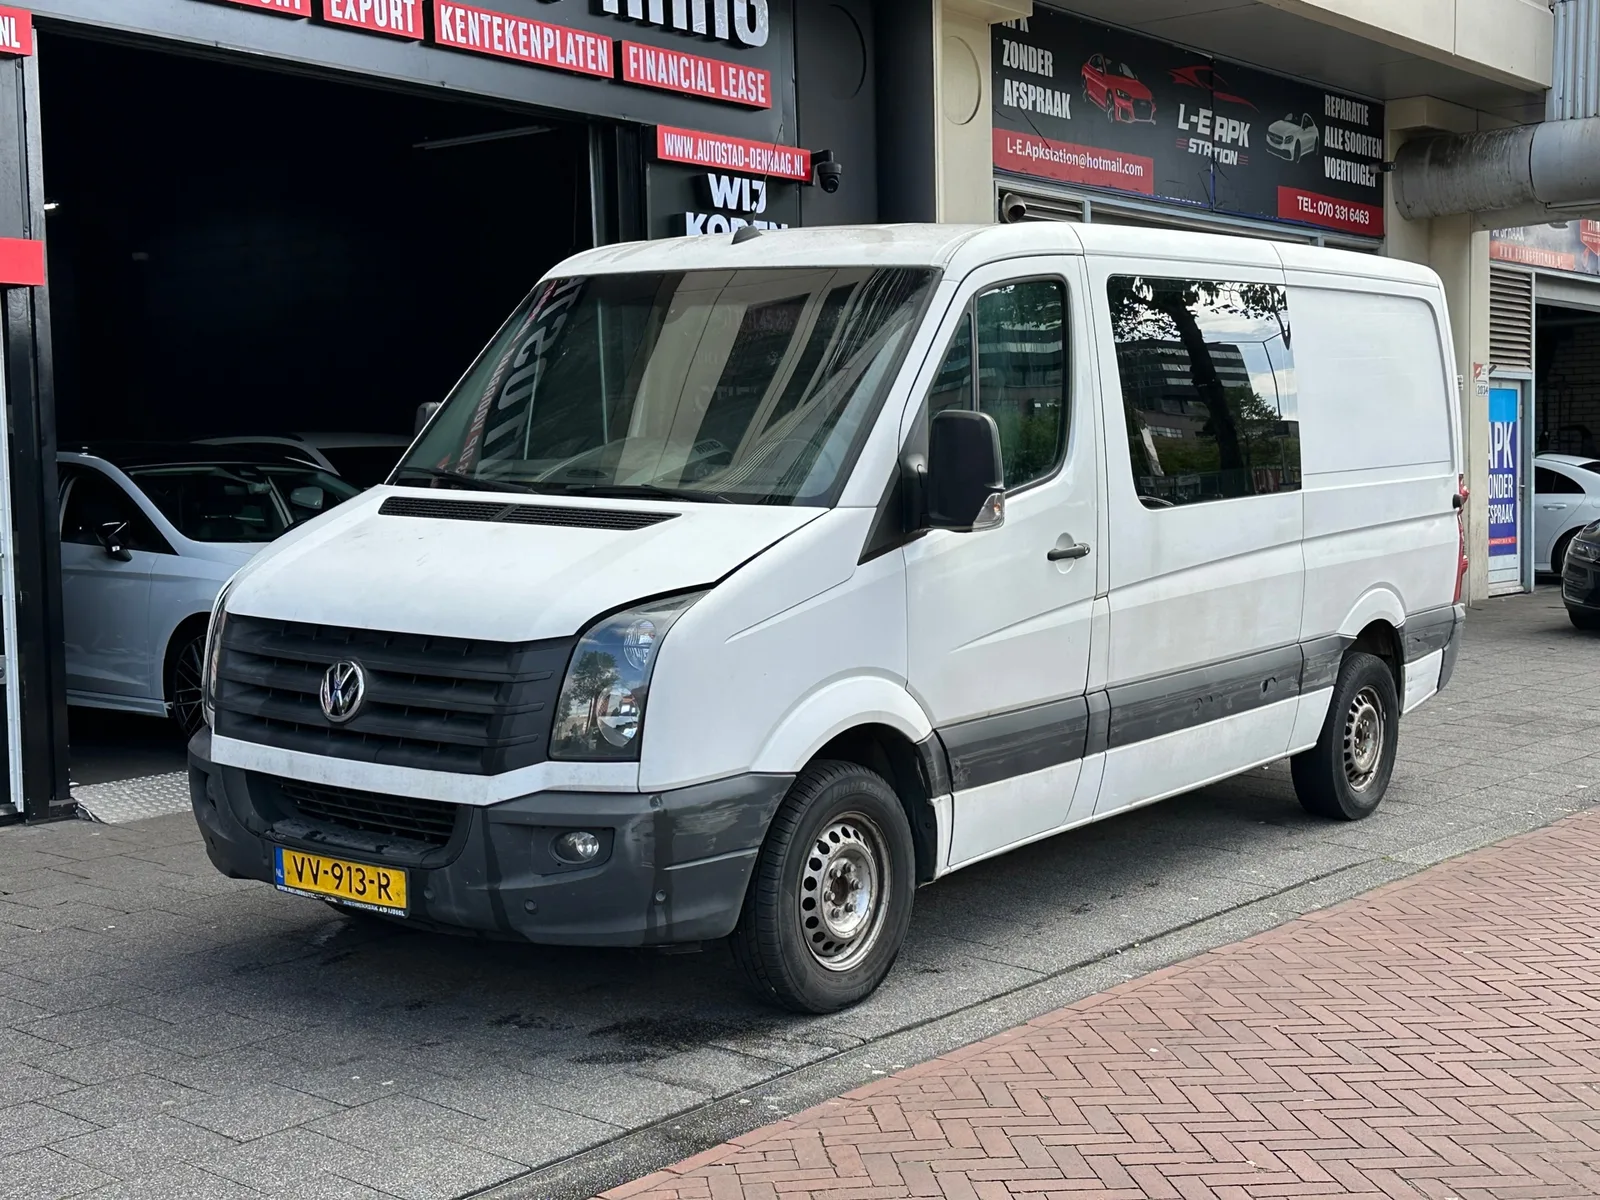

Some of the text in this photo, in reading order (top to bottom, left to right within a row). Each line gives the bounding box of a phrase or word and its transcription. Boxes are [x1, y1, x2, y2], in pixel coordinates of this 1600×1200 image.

[440, 4, 609, 72] KENTEKENPLATEN
[1003, 38, 1053, 77] ZONDER
[629, 46, 766, 103] FINANCIAL LEASE
[1003, 78, 1071, 119] AFSPRAAK
[1324, 94, 1369, 126] REPARATIE
[1177, 103, 1251, 148] L-E APK
[1324, 125, 1382, 159] ALLE SOORTEN
[664, 132, 806, 177] WWW.AUTOSTAD-DENHAAG.NL
[1007, 137, 1143, 177] L-E.Apkstation@hotmail.com
[1188, 137, 1238, 166] STATION
[707, 172, 767, 214] WIJ
[1297, 195, 1370, 224] TEL: 070 331 6463
[1488, 502, 1514, 525] SPRAAK
[292, 854, 394, 902] VV-913-R
